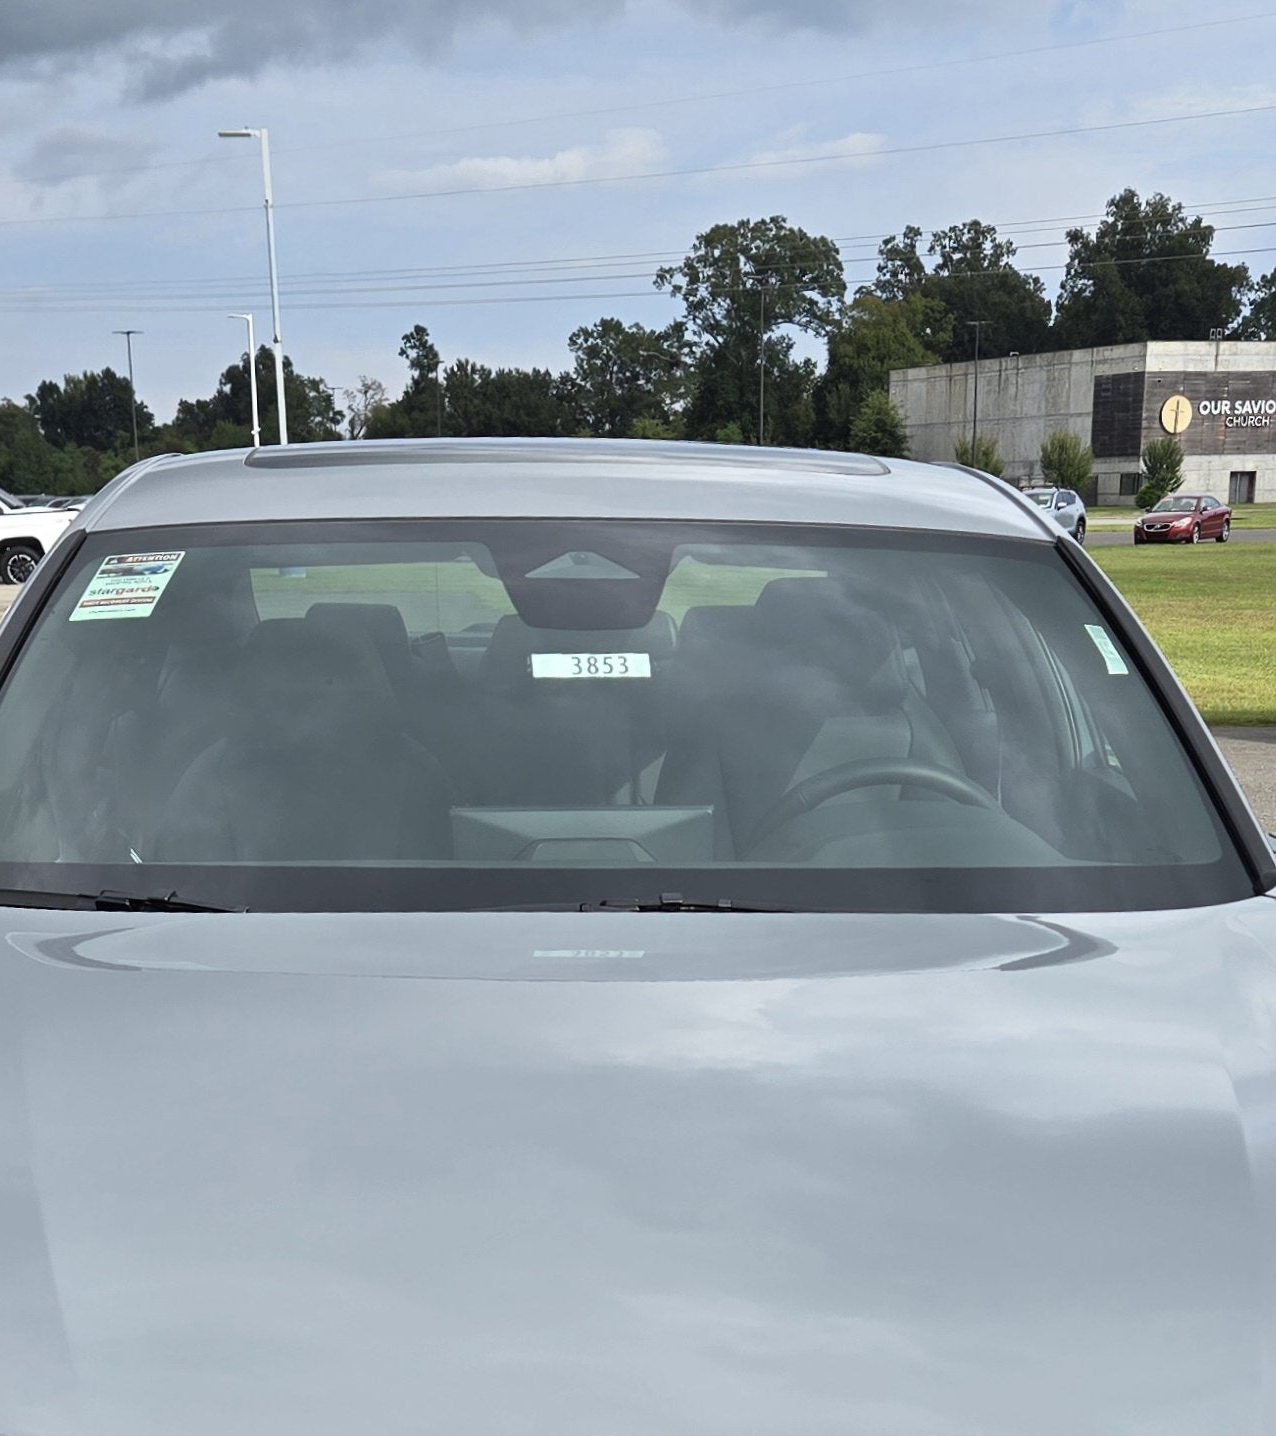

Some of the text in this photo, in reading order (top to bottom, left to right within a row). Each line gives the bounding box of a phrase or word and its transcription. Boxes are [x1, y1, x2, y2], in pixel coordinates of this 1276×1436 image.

[1199, 400, 1231, 415] OUR
[1225, 416, 1270, 428] CHURCH
[571, 656, 629, 675] 3853
